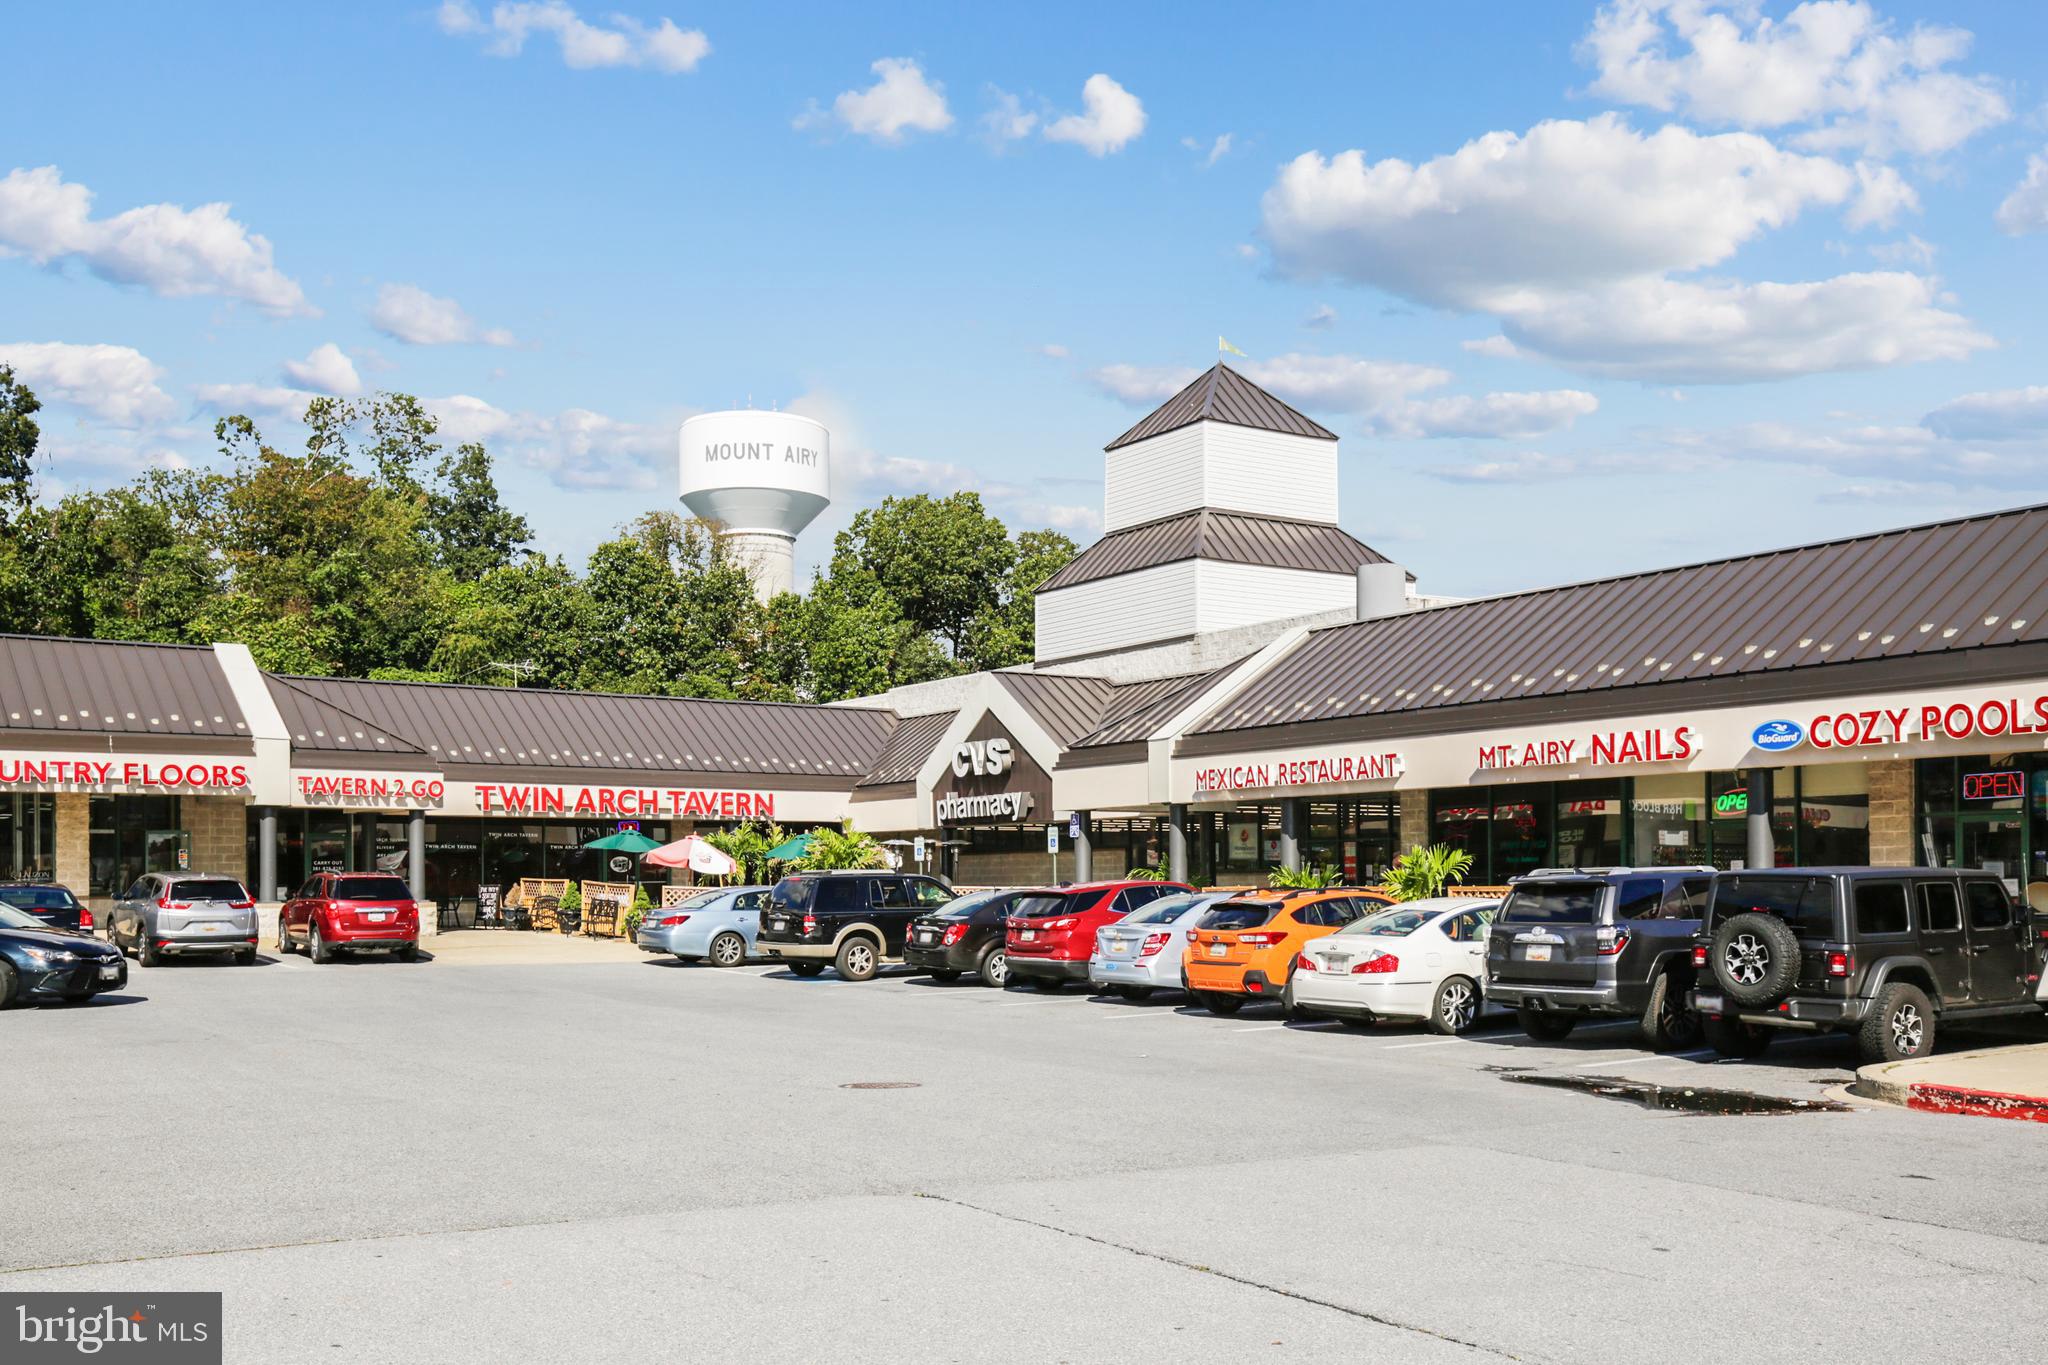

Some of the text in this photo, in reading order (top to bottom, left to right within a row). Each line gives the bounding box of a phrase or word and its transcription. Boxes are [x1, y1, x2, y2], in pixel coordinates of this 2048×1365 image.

[705, 442, 818, 468] MOUNT AIRY
[1758, 732, 1797, 744] BioGuard
[1809, 696, 2048, 749] COZY POOLS
[951, 738, 1012, 777] CVS
[1479, 726, 1692, 769] MT. AIRY NAILS
[123, 762, 248, 788] FLOORS
[298, 776, 445, 799] TAVERN 2 GO
[1196, 753, 1397, 790] MEXICAN RESTAURANT
[1965, 774, 2024, 798] OPEN
[475, 785, 774, 817] TWIN ARCH TAVERN
[936, 791, 1023, 826] pharmacy
